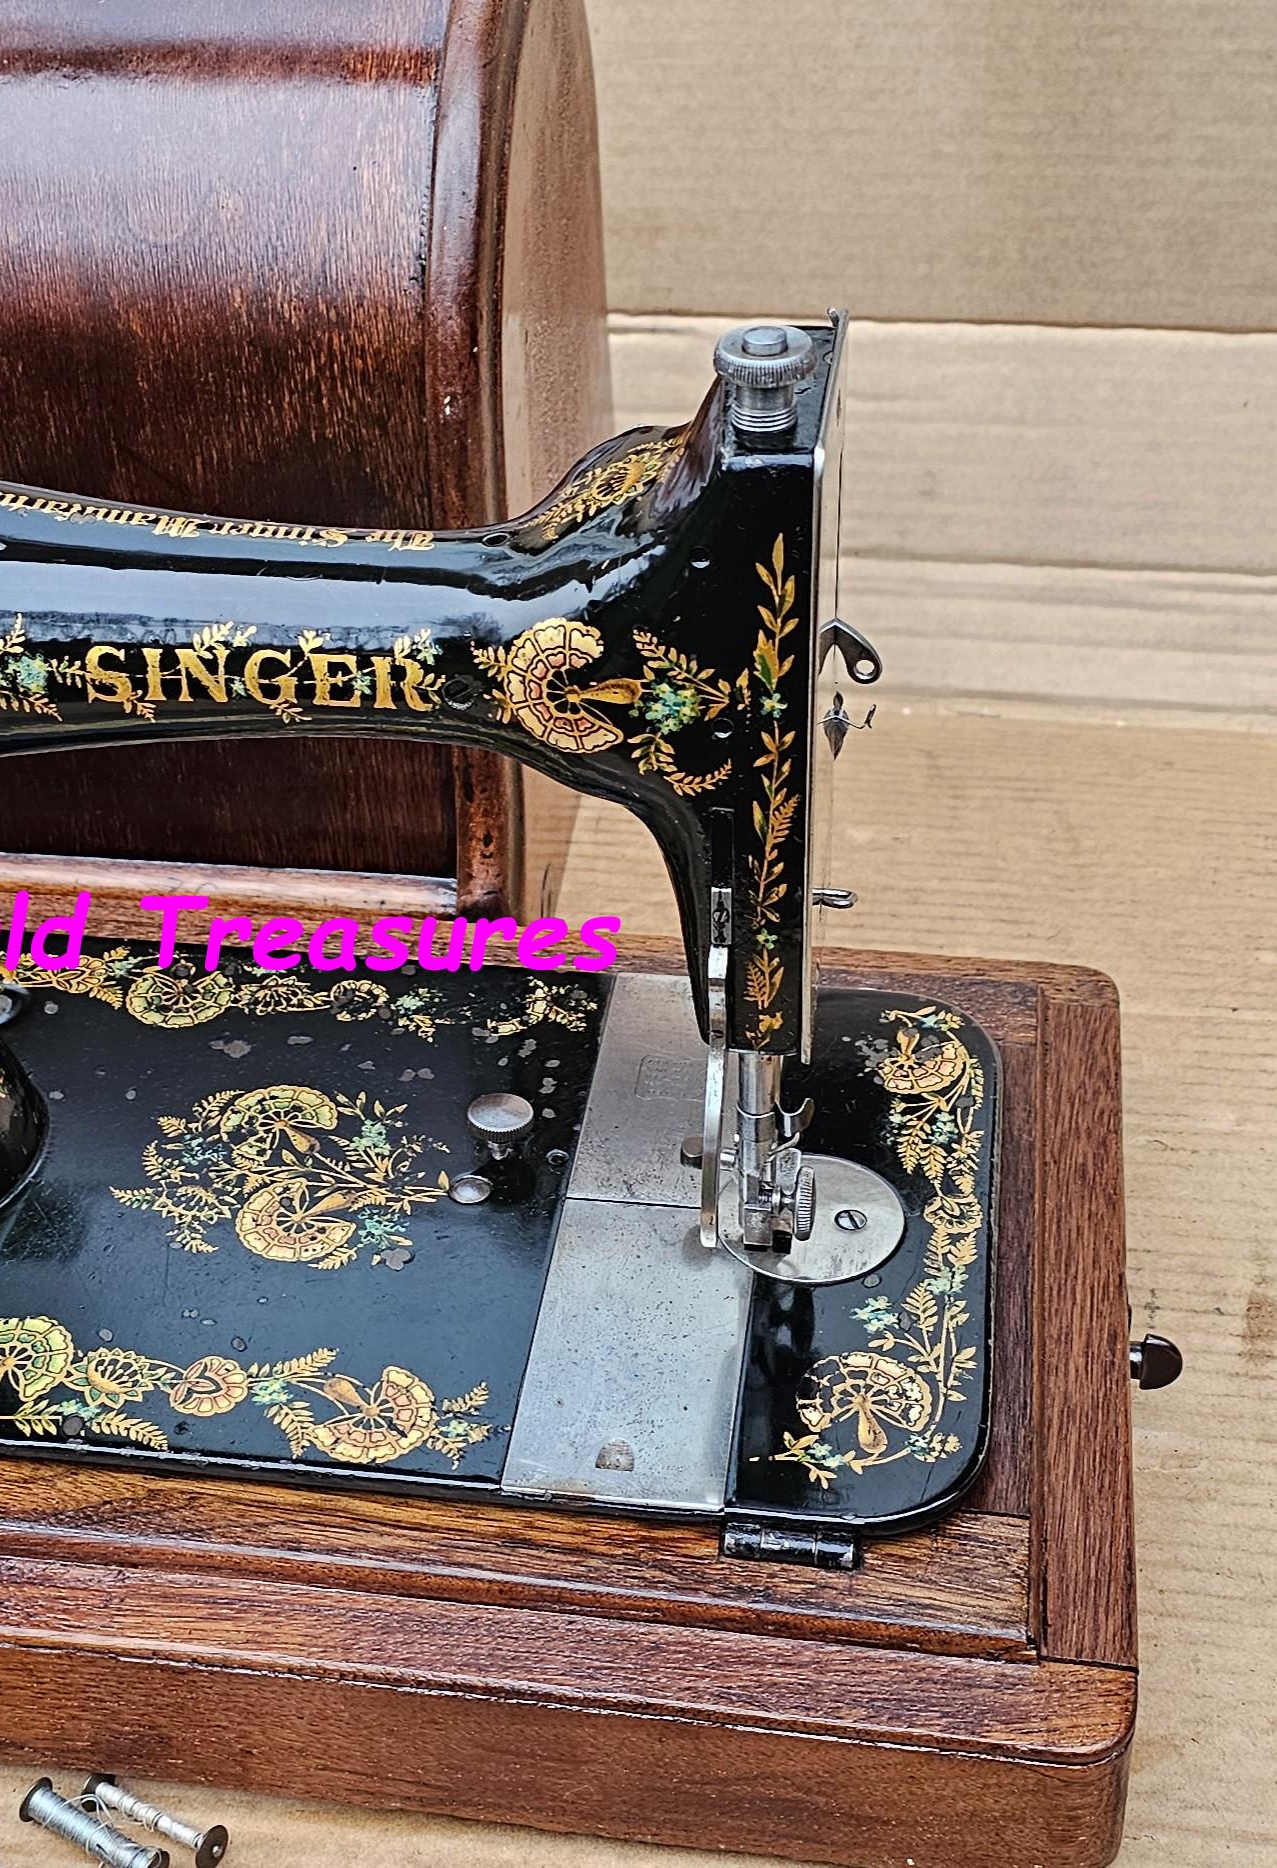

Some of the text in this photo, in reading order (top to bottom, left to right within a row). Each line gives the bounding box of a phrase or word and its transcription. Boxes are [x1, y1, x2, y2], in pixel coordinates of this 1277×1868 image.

[210, 521, 352, 548] Singer
[365, 529, 436, 552] The
[84, 645, 435, 712] SINGER
